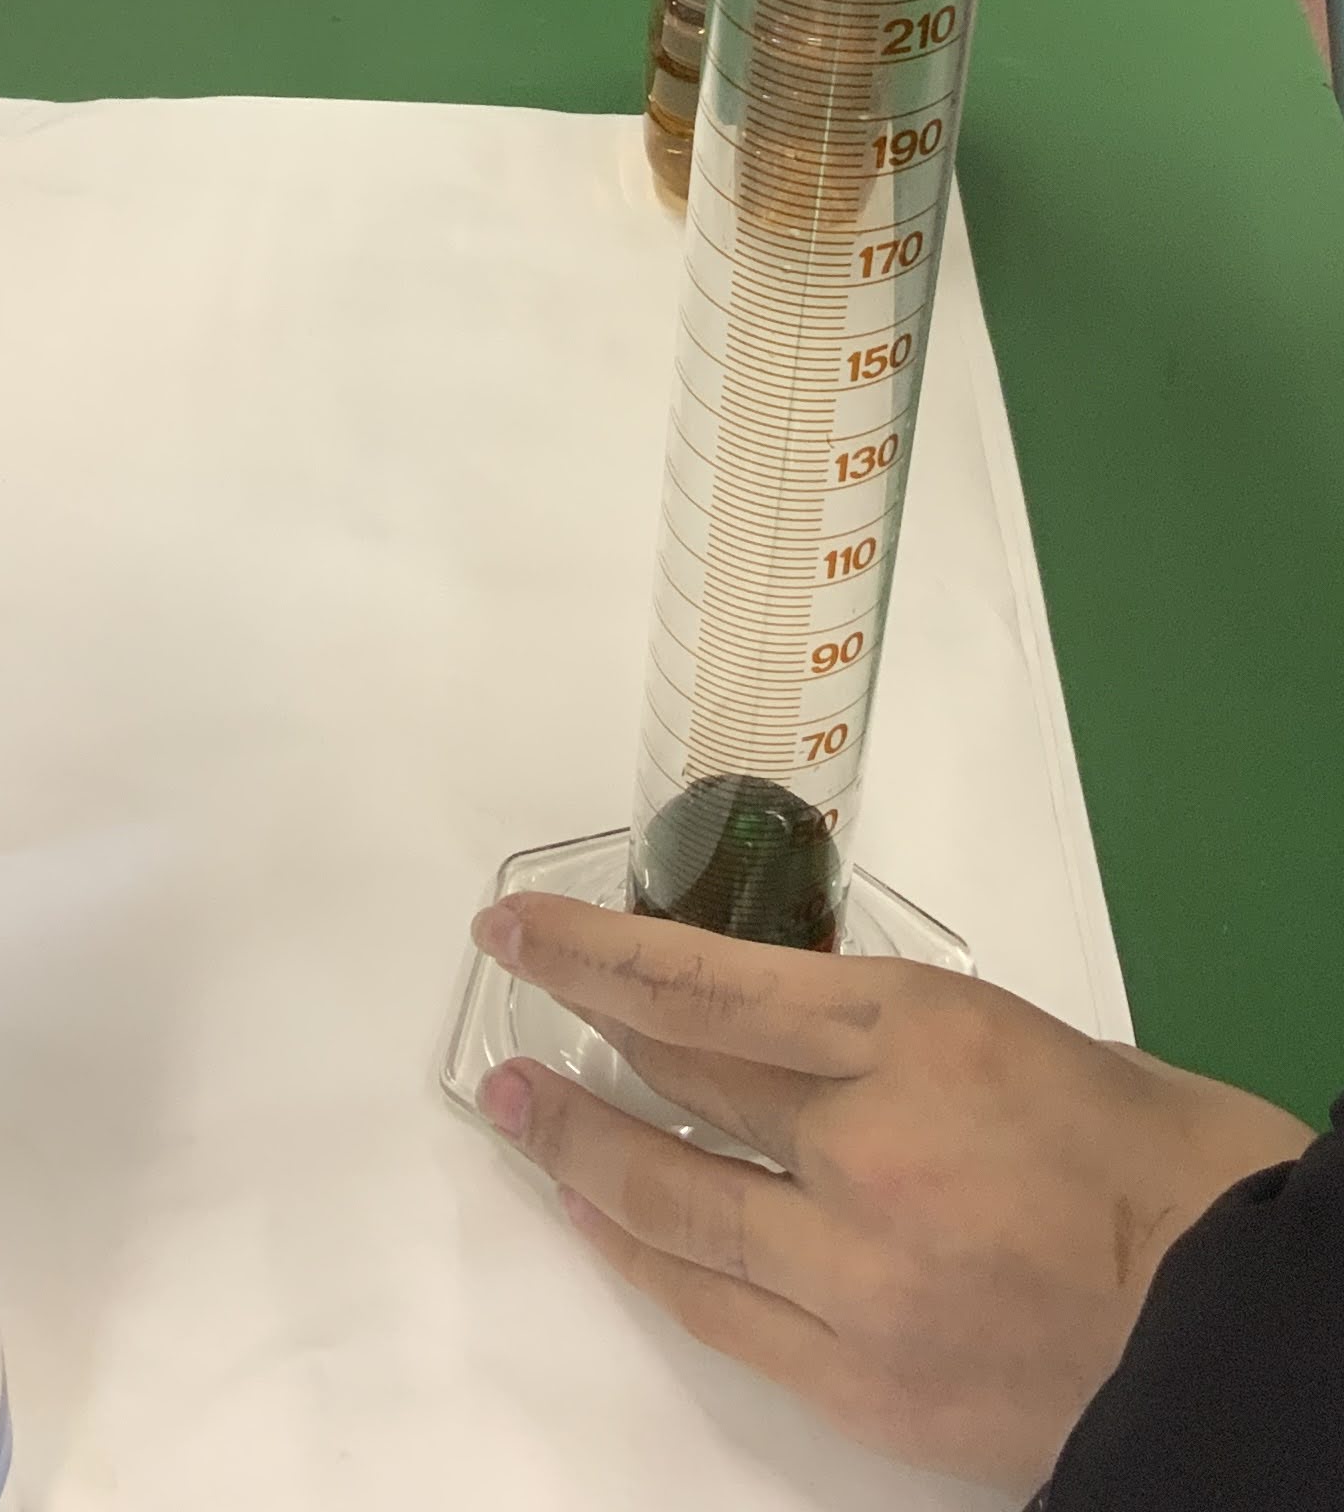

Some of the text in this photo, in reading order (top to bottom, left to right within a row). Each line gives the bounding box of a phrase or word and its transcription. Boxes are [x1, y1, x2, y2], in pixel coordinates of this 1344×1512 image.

[880, 5, 956, 55] 210
[872, 118, 943, 168] 190
[858, 231, 923, 278] 170
[846, 333, 912, 381] 150
[834, 433, 899, 482] 130
[823, 537, 876, 579] 110
[810, 632, 863, 674] 90
[801, 723, 848, 761] 70
